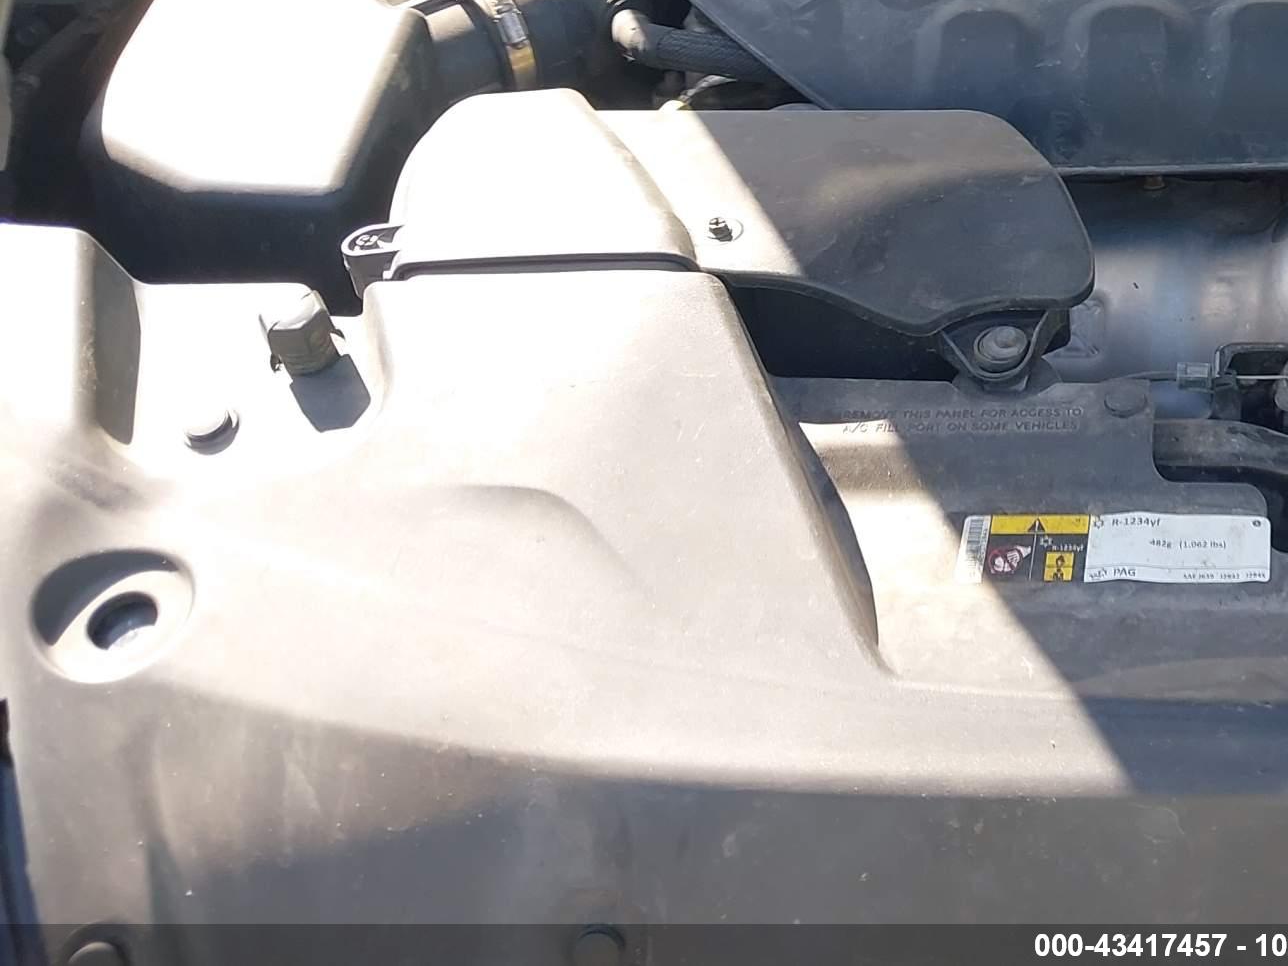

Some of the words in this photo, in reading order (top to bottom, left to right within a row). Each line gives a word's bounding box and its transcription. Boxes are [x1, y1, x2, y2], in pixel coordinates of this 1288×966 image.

[903, 409, 931, 419] THIS
[936, 409, 976, 419] PANEL
[981, 409, 1007, 418] FOR
[1010, 408, 1061, 418] ACCESS
[1066, 408, 1083, 417] TO
[842, 422, 869, 434] A/C
[908, 422, 942, 433] PORT
[947, 422, 967, 432] ON
[972, 422, 1009, 432] SOME
[1015, 420, 1079, 431] VEHICLES
[1111, 517, 1161, 528] R-1234yf
[1113, 567, 1137, 578] PAG
